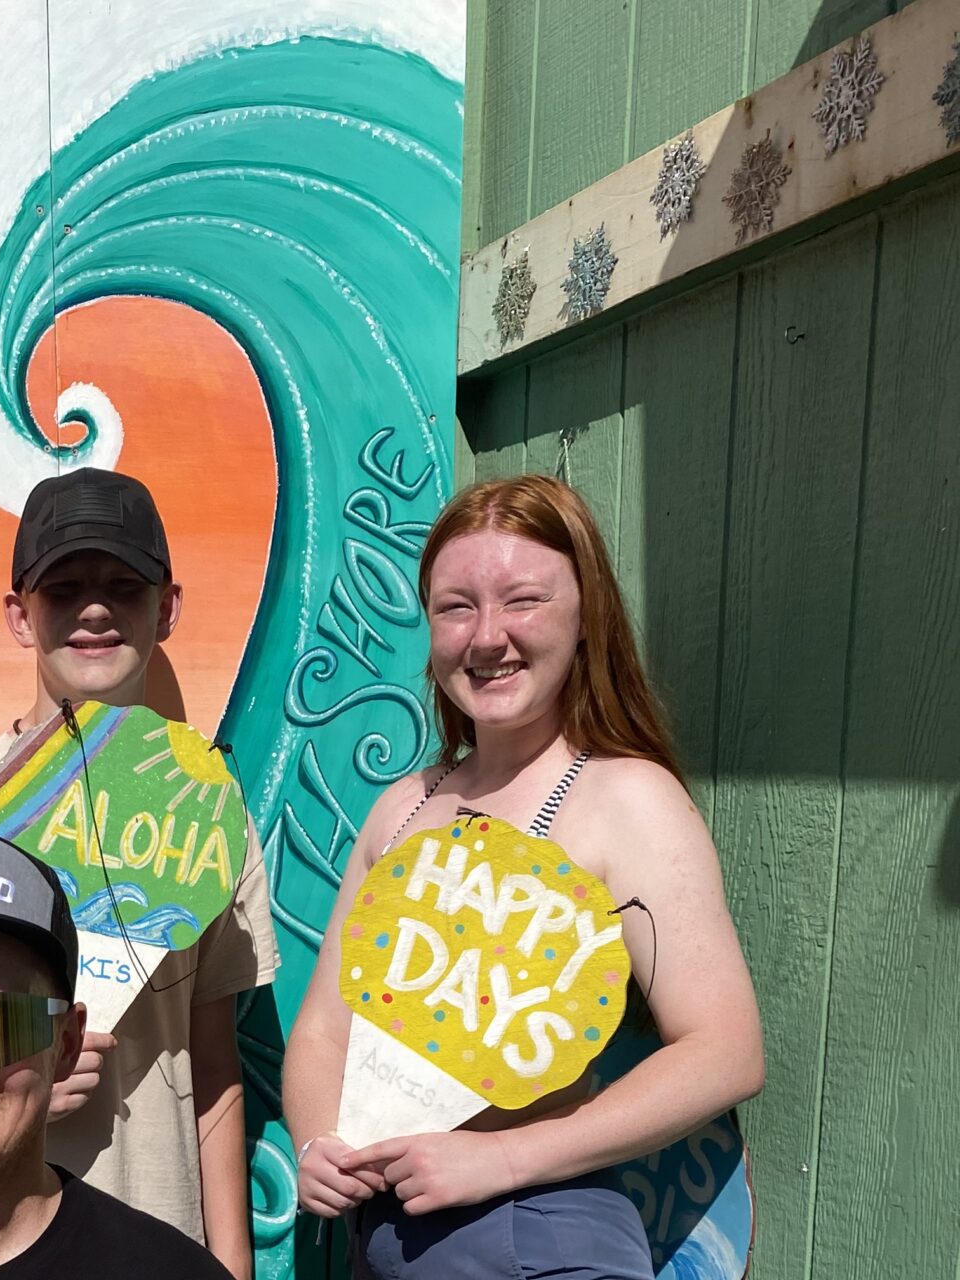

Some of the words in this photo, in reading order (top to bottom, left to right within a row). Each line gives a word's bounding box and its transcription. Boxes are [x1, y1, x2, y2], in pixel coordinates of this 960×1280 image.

[283, 426, 437, 781] SHORE
[37, 778, 234, 893] ALOHA
[79, 954, 132, 984] KI'S
[404, 837, 623, 993] HAPPY
[383, 917, 575, 1078] DAYS
